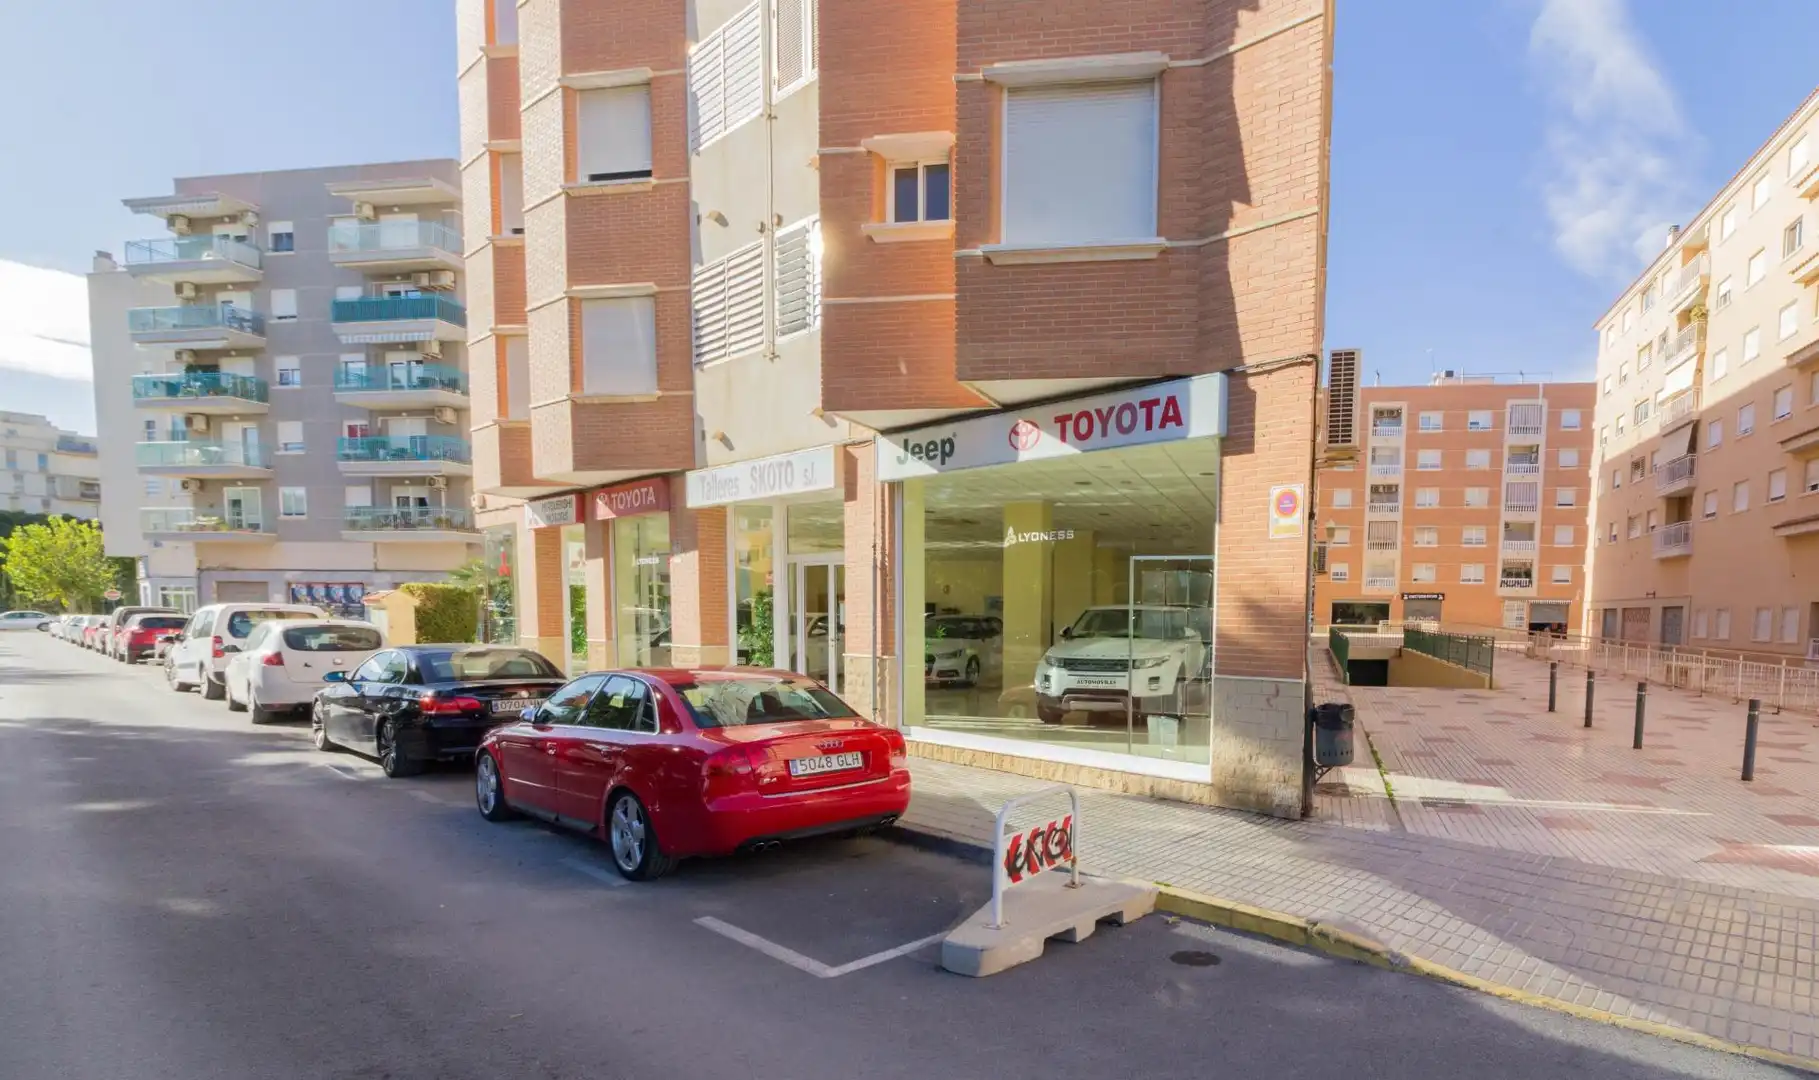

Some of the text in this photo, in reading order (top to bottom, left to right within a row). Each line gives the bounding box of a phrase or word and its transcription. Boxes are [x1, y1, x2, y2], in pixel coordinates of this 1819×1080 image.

[1054, 395, 1184, 443] TOYOTA
[896, 437, 956, 466] Jeep
[699, 473, 740, 501] Talleres
[750, 460, 795, 495] SKOTO
[611, 486, 656, 510] TOYOTA
[1018, 529, 1075, 542] LYONESS
[799, 753, 860, 772] 5048 GLH
